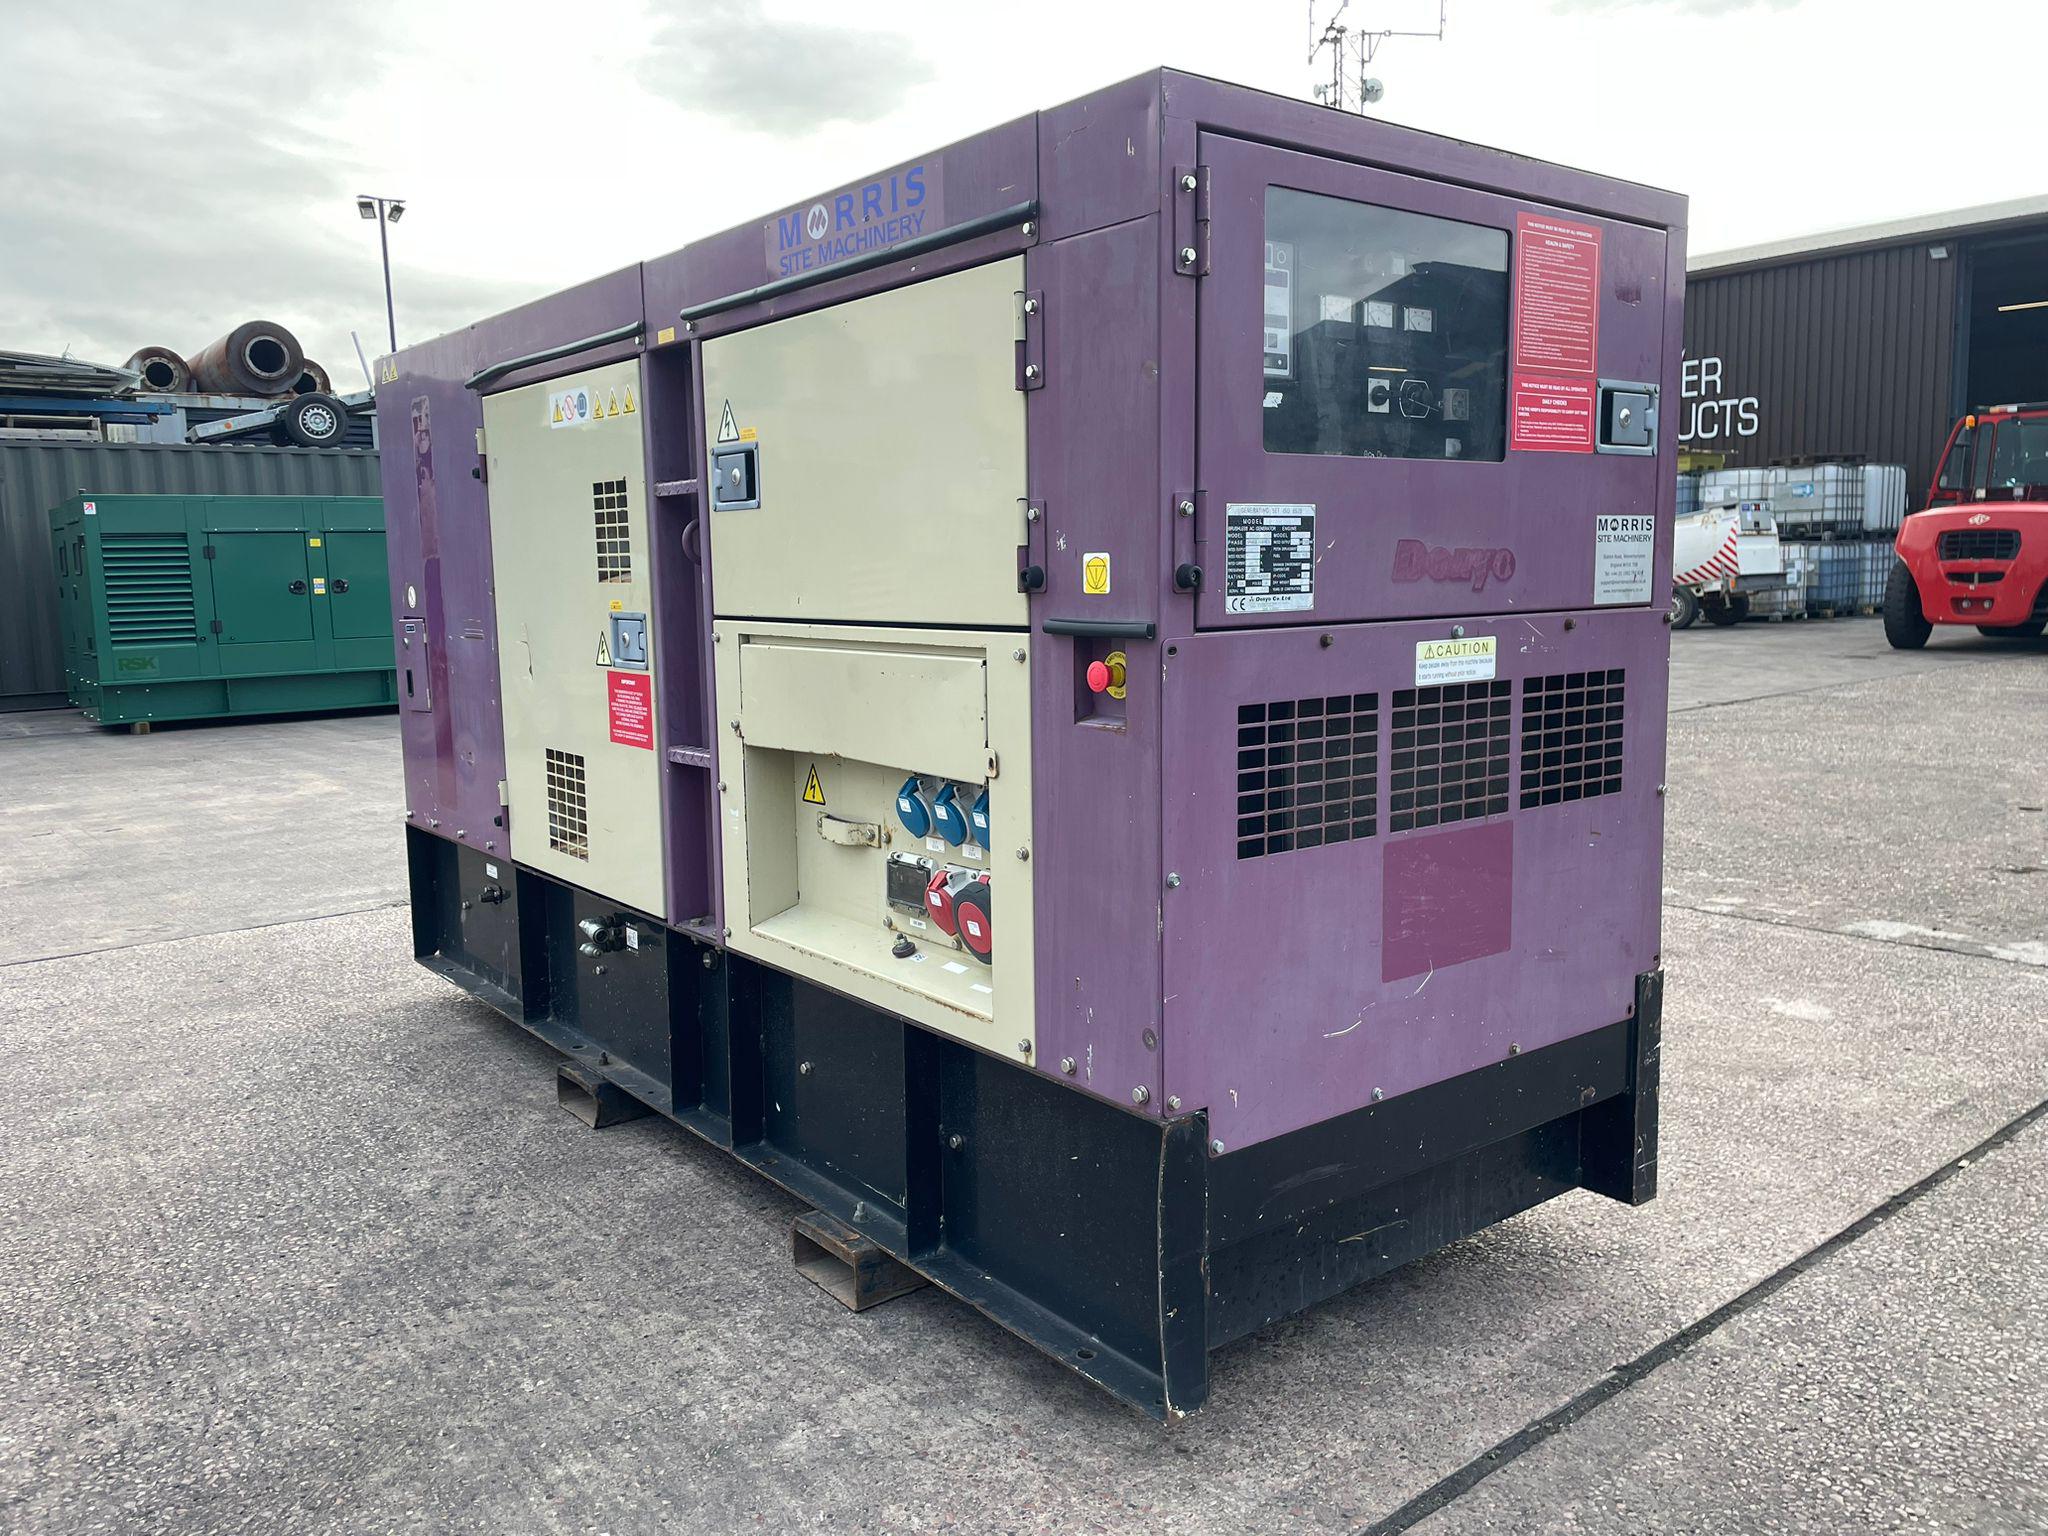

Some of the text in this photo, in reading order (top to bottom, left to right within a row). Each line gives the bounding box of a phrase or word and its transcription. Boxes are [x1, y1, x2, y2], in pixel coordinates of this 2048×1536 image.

[778, 166, 926, 251] MORRIS
[780, 209, 926, 276] SITE MACHINERY
[1598, 518, 1652, 531] MORRIS
[1613, 533, 1652, 542] MACHINERY
[1437, 642, 1488, 656] CAUTION
[118, 656, 157, 671] RSK
